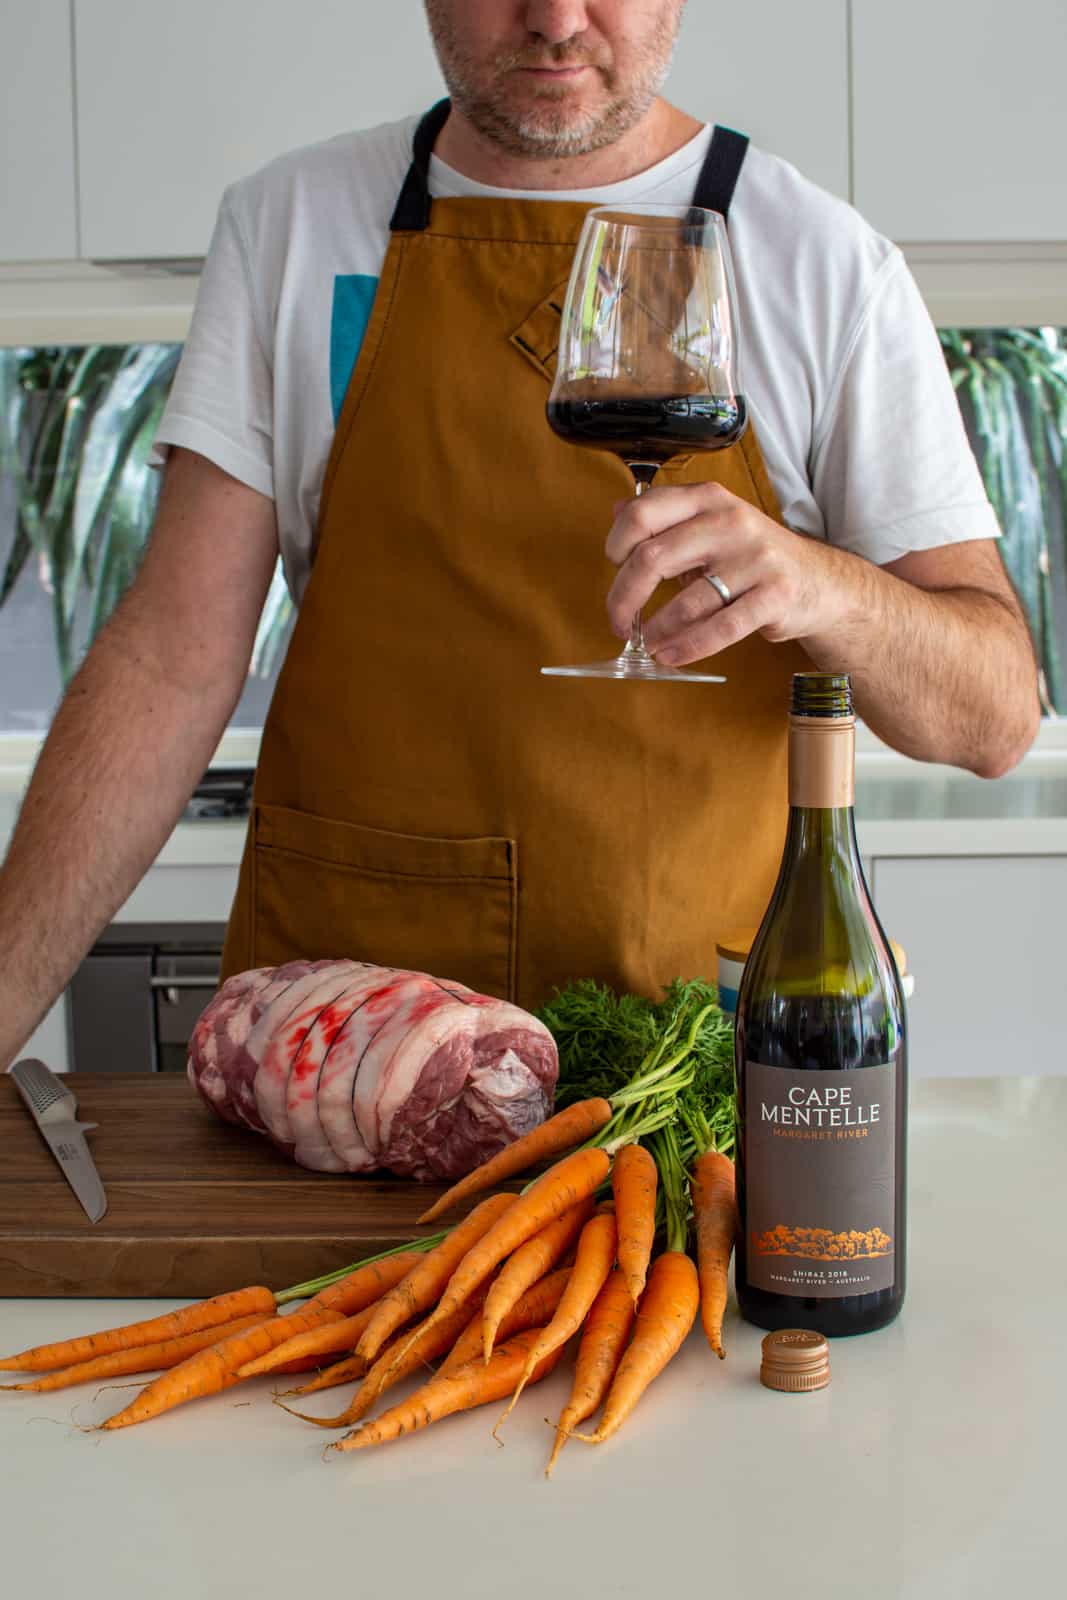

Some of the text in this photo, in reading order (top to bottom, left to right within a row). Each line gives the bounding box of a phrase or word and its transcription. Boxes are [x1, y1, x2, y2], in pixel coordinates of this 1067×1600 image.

[788, 1087, 852, 1106] CAPE
[761, 1102, 880, 1126] MENTELLE
[773, 1127, 869, 1140] MARGARET RIVER
[793, 1270, 825, 1278] SHIRAZ
